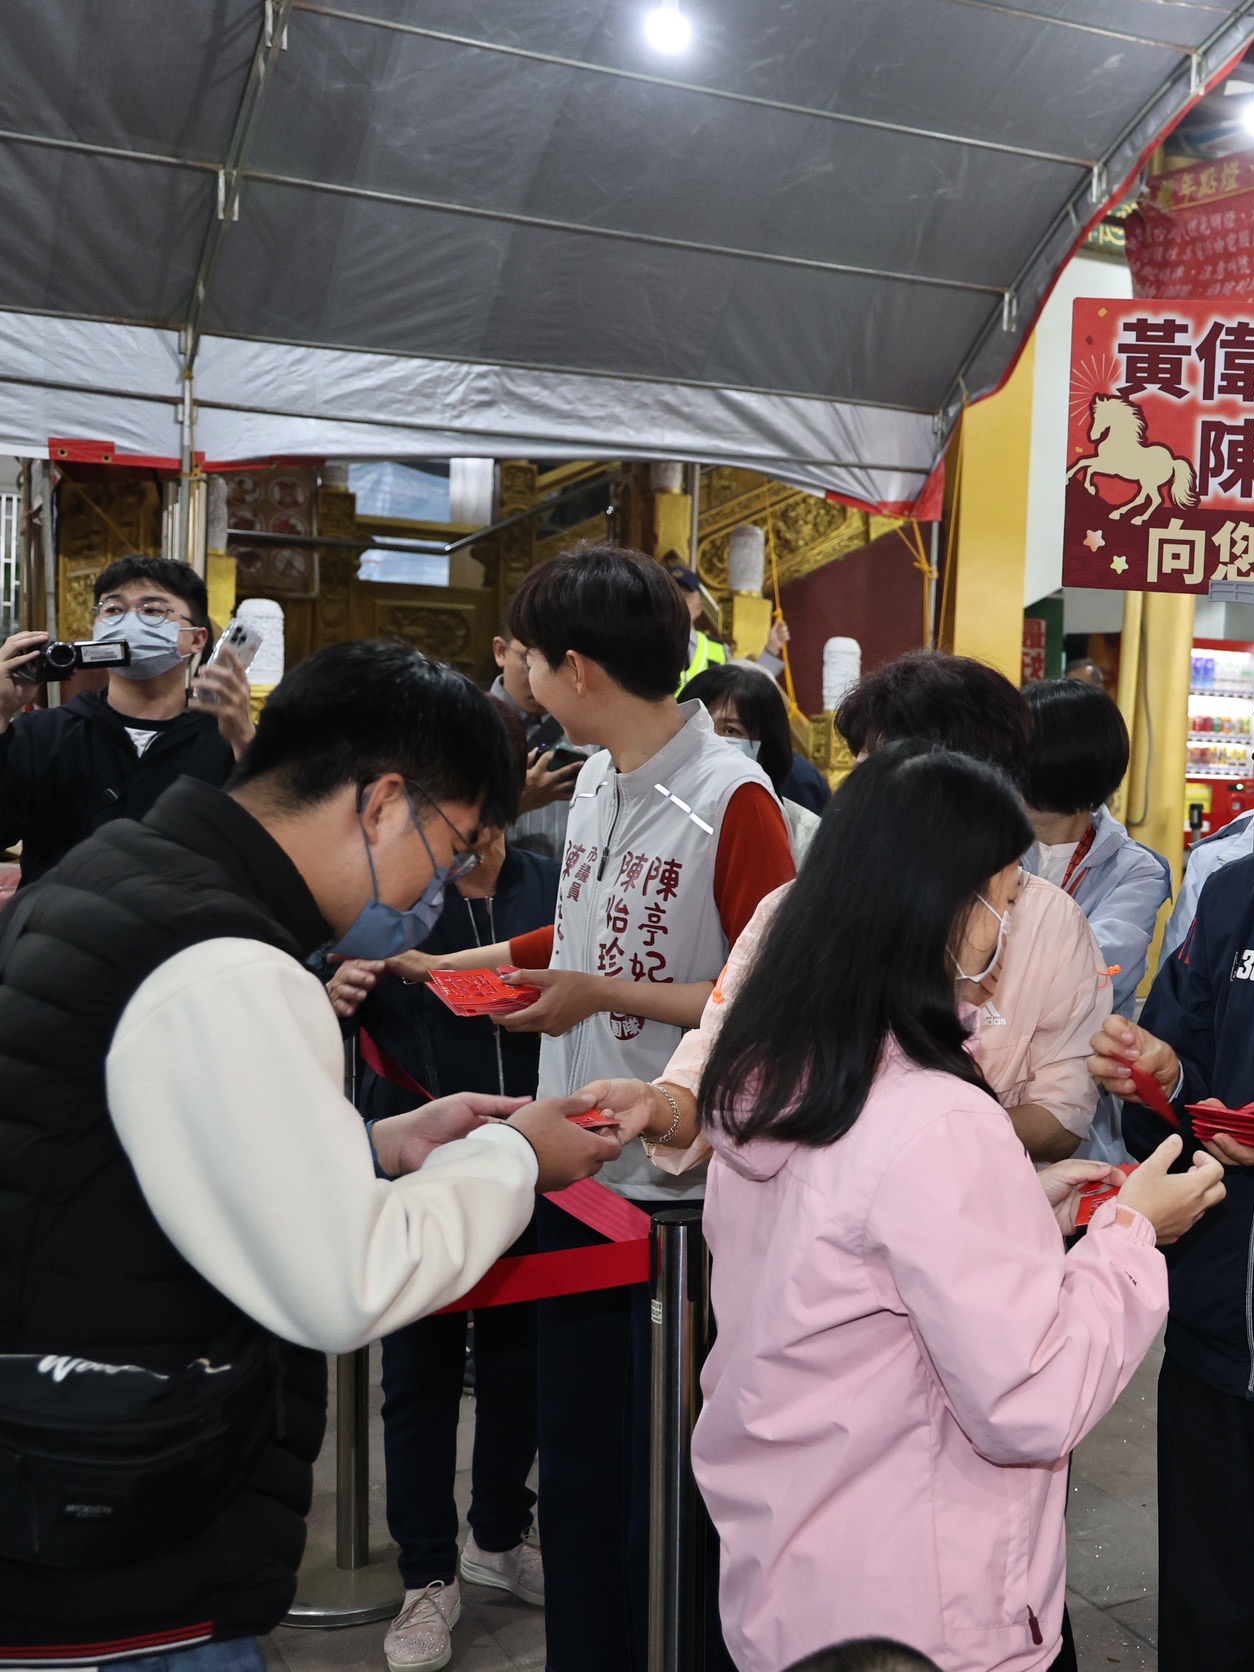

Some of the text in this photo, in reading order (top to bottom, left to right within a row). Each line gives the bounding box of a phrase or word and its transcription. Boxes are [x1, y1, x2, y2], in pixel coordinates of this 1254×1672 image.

[598, 851, 649, 977] 陳怡珍
[629, 857, 683, 983] 陳亭妃
